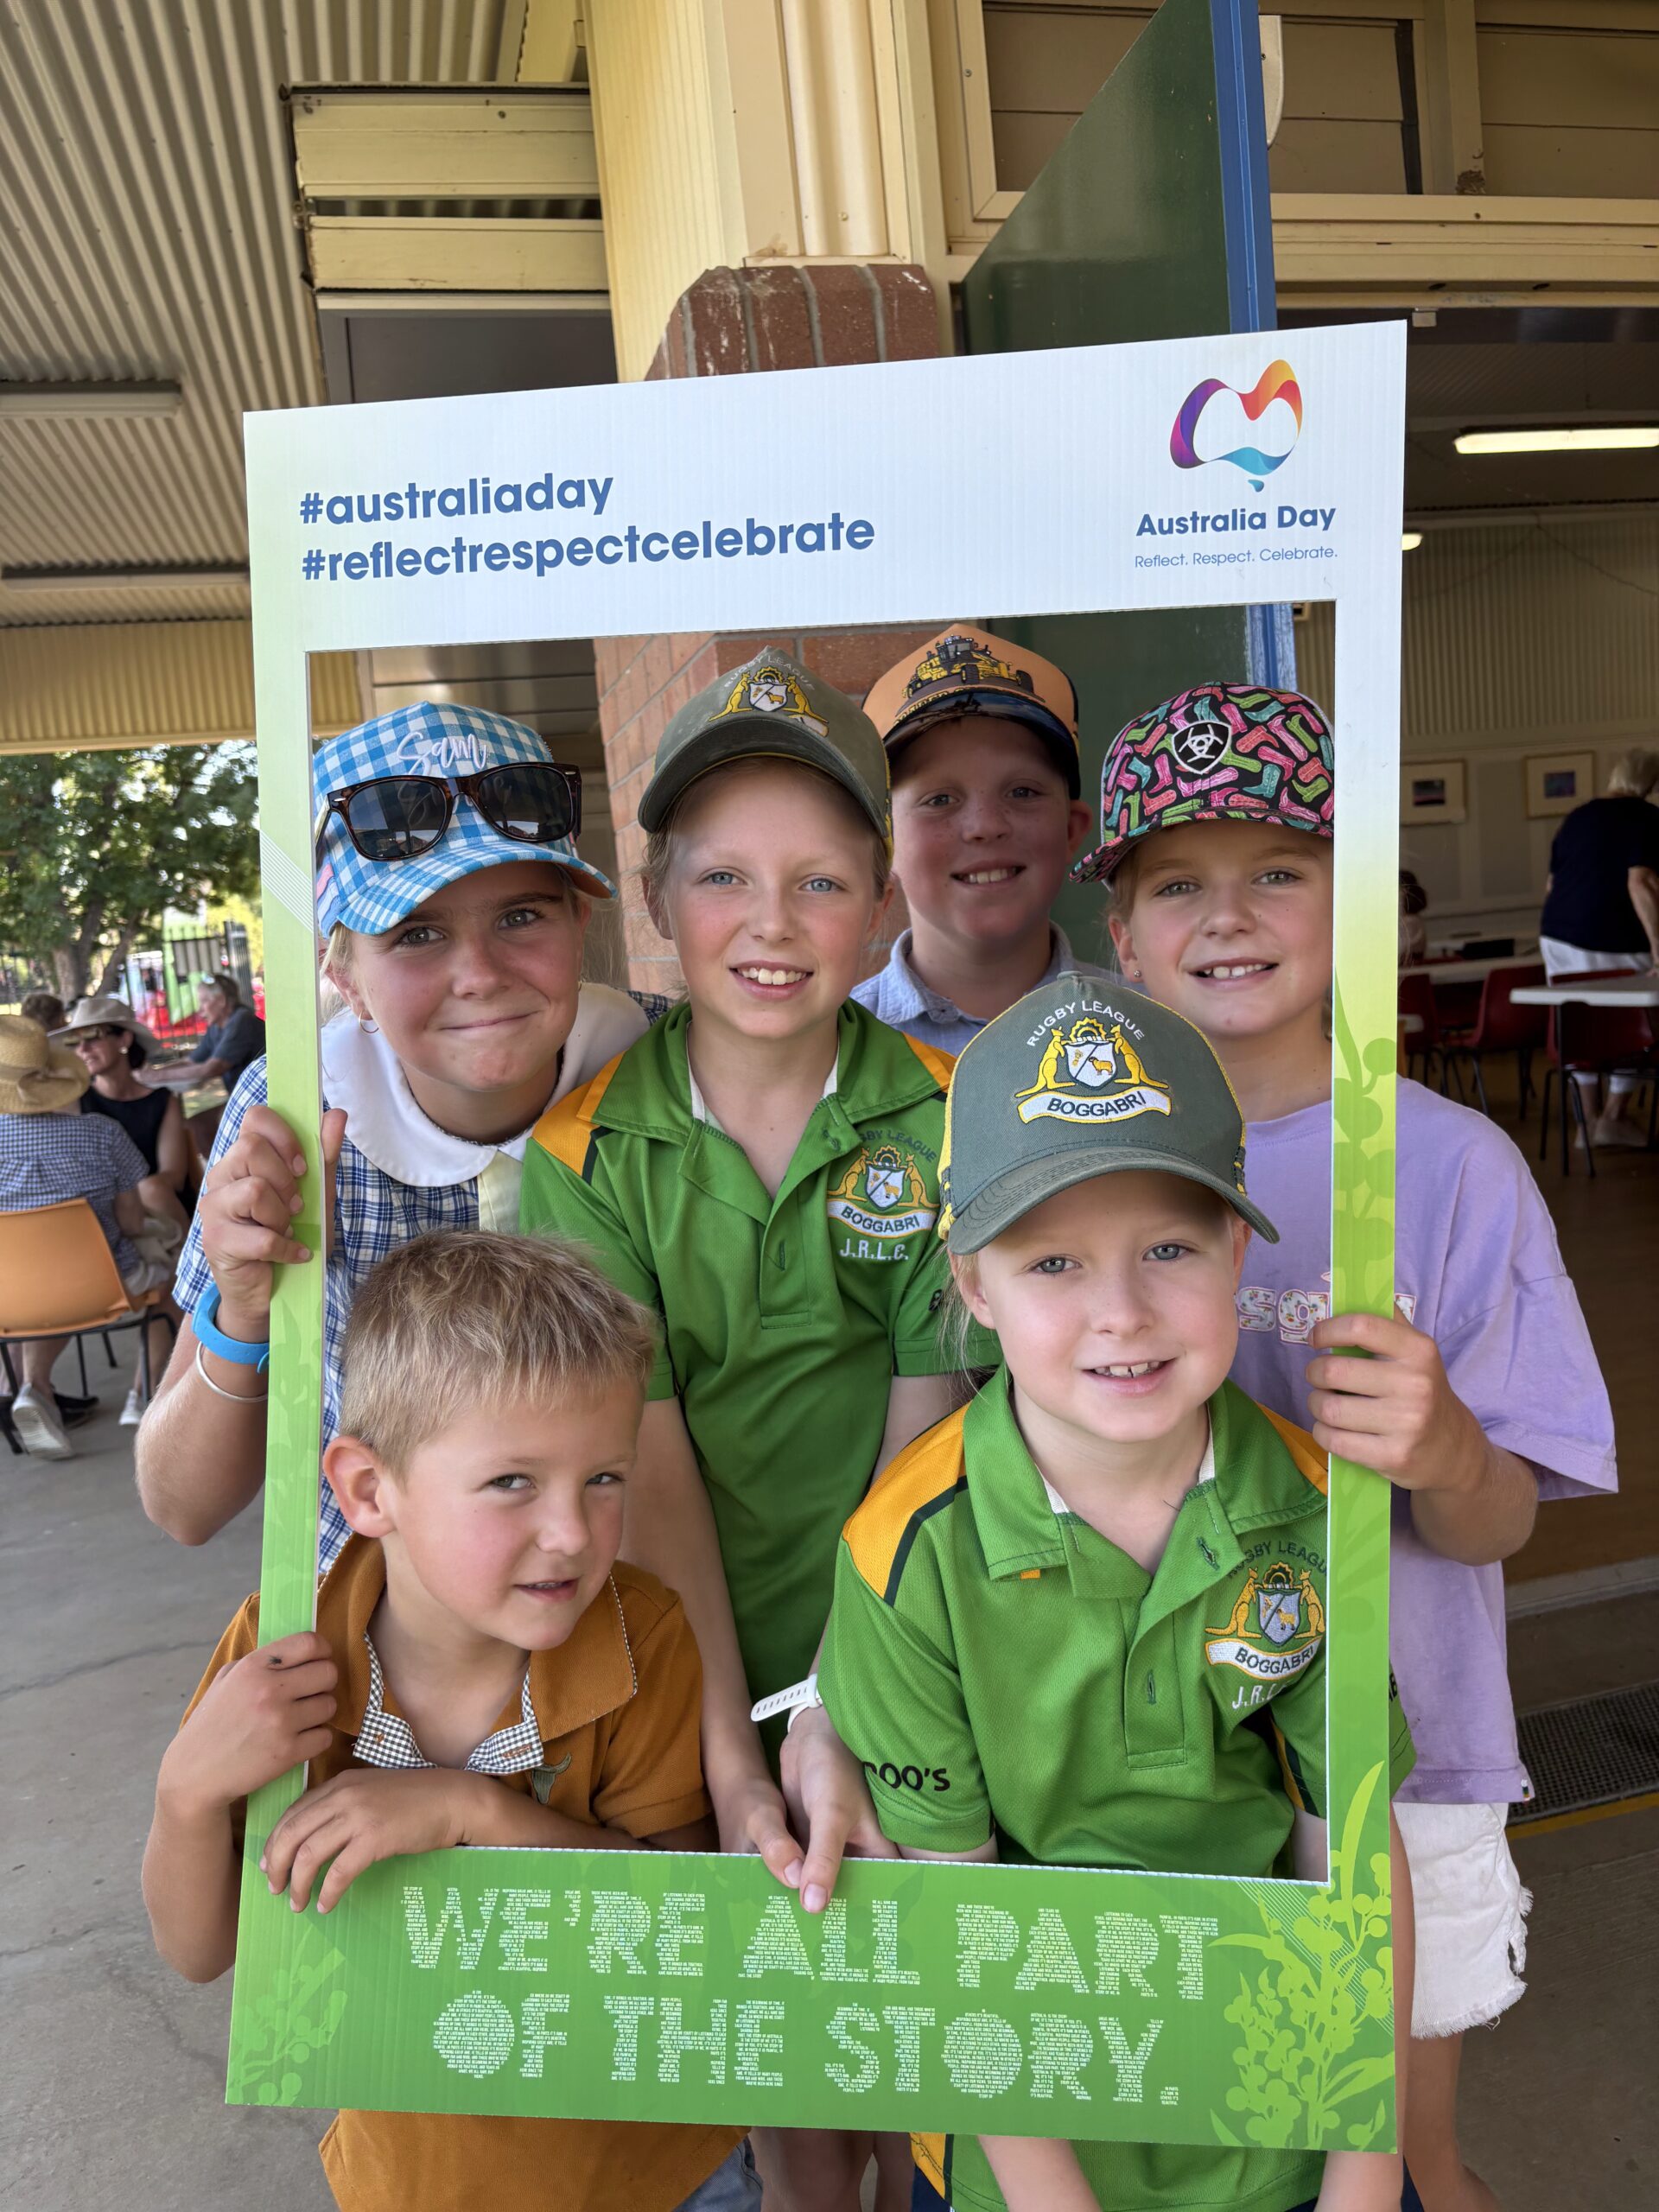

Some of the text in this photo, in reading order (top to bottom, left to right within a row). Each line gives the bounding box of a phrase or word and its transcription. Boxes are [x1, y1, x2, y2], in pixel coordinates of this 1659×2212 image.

[299, 473, 613, 524] #australiaday
[1135, 505, 1336, 536] Australia Day
[302, 512, 874, 581] #reflectrespectcelebrate
[1135, 546, 1338, 568] Reflect. Respect. Celebrate.
[1027, 1000, 1145, 1046] RUGBY LEAGUE
[1047, 1091, 1147, 1117] BOGGABRI
[887, 1130, 937, 1163] LEAGUE
[841, 1205, 920, 1233] BOGGABRI
[1279, 1541, 1326, 1575] LEAGU
[1235, 1646, 1314, 1675] BOGGABRI
[400, 1886, 706, 1977] WE'RE
[738, 1895, 920, 1985] ALL
[956, 1904, 1219, 2000] PART
[433, 1990, 570, 2079] OF
[603, 1994, 785, 2087] THE
[824, 2002, 1179, 2106] STORY.
